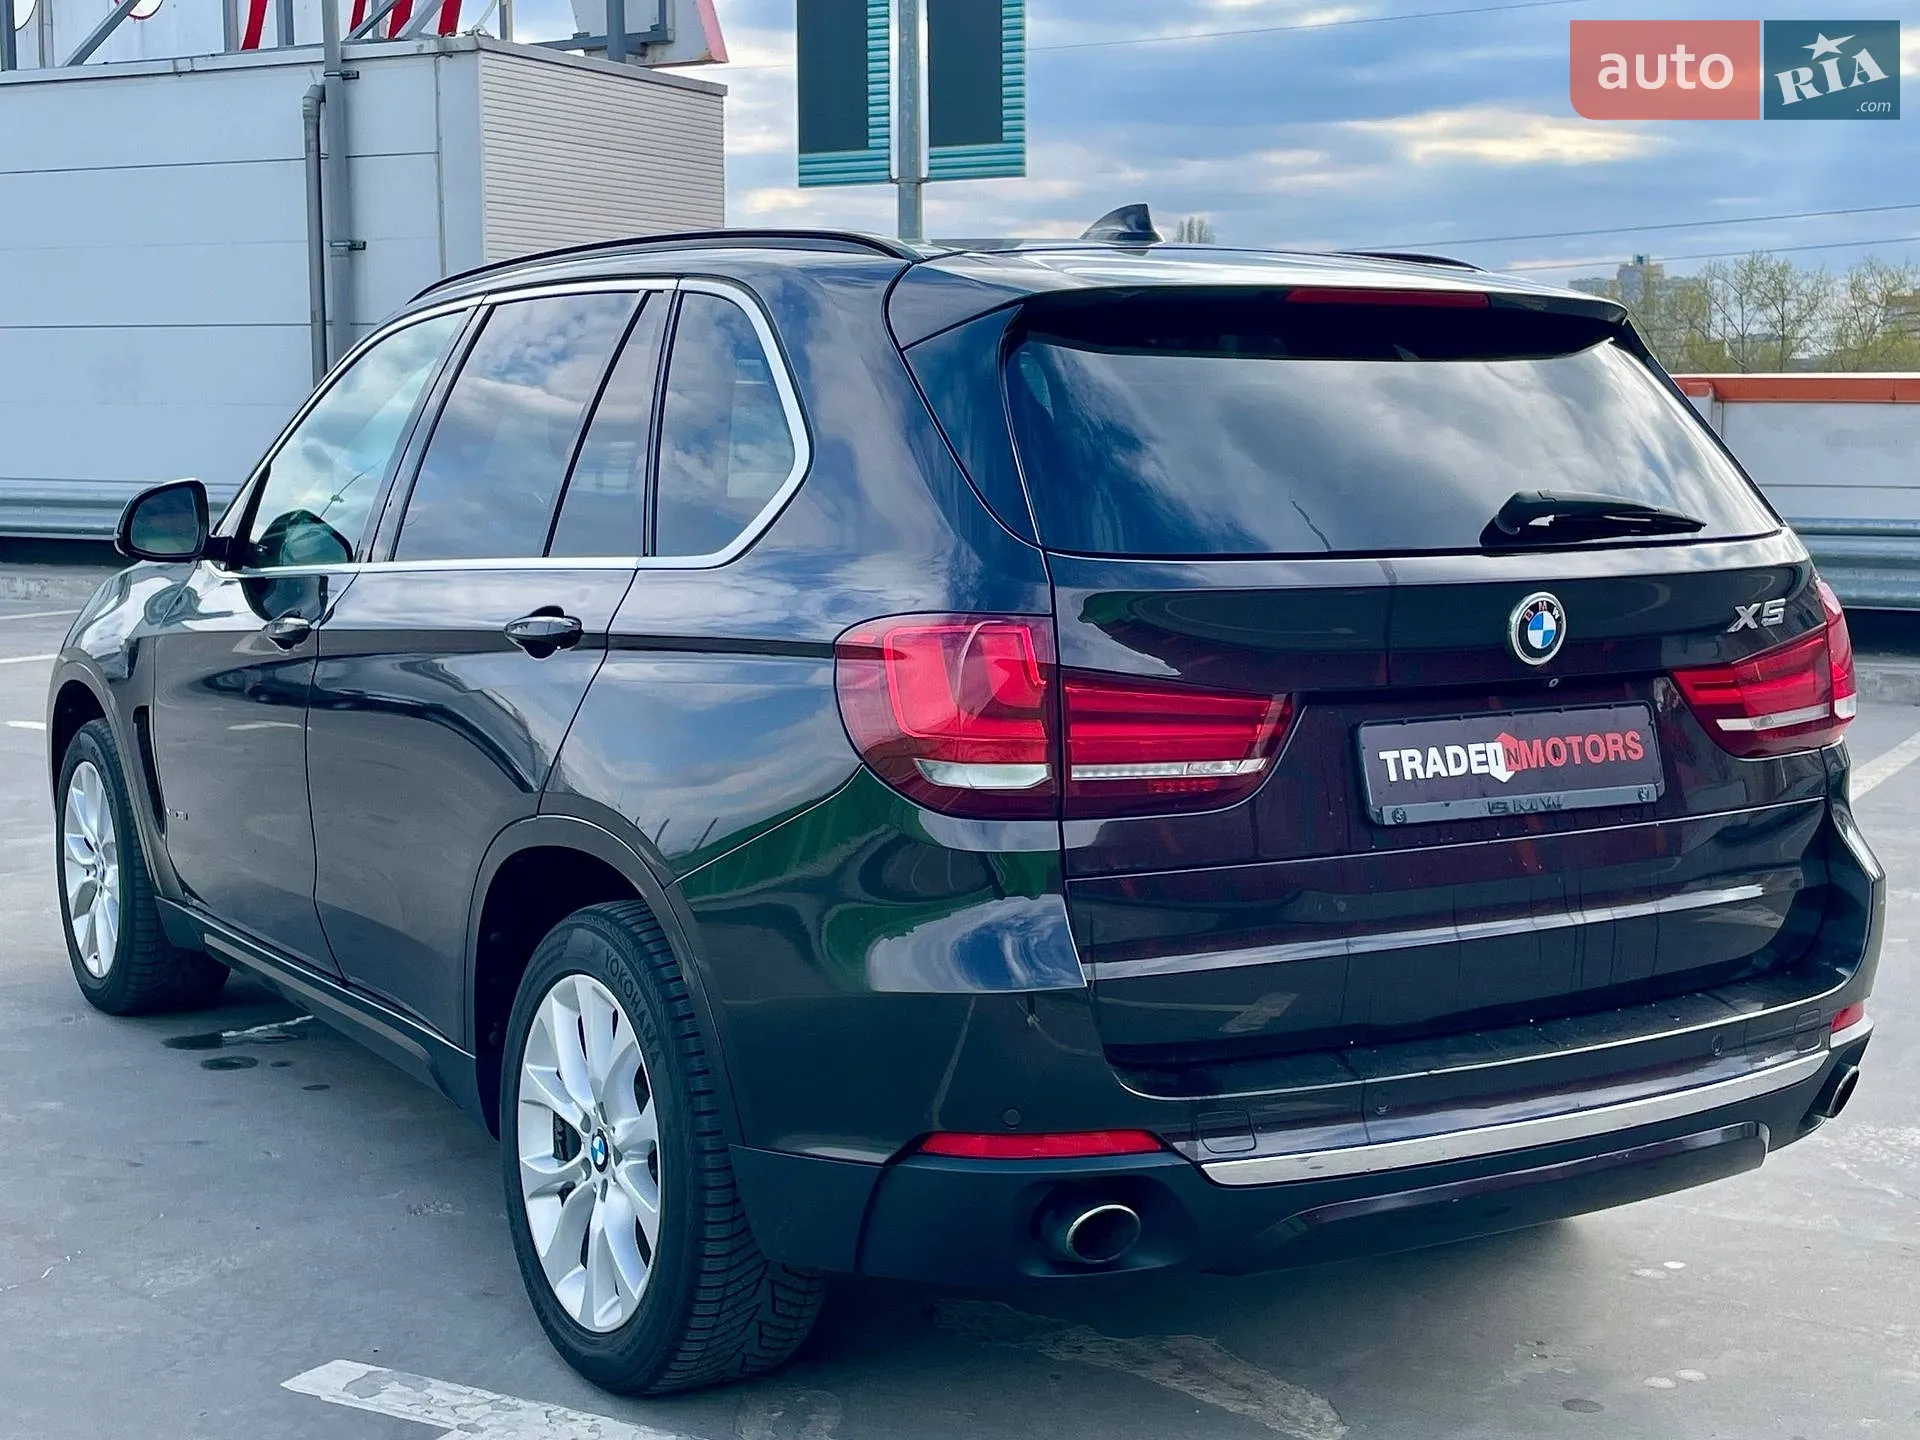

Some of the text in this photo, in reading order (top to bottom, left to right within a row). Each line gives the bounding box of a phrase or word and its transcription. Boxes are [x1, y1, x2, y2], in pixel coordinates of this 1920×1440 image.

[1523, 600, 1560, 621] BMW
[1728, 598, 1786, 632] X5
[1518, 730, 1645, 769] MOTORS
[1487, 795, 1562, 815] BMW
[604, 949, 661, 1068] YOKOHAMA
